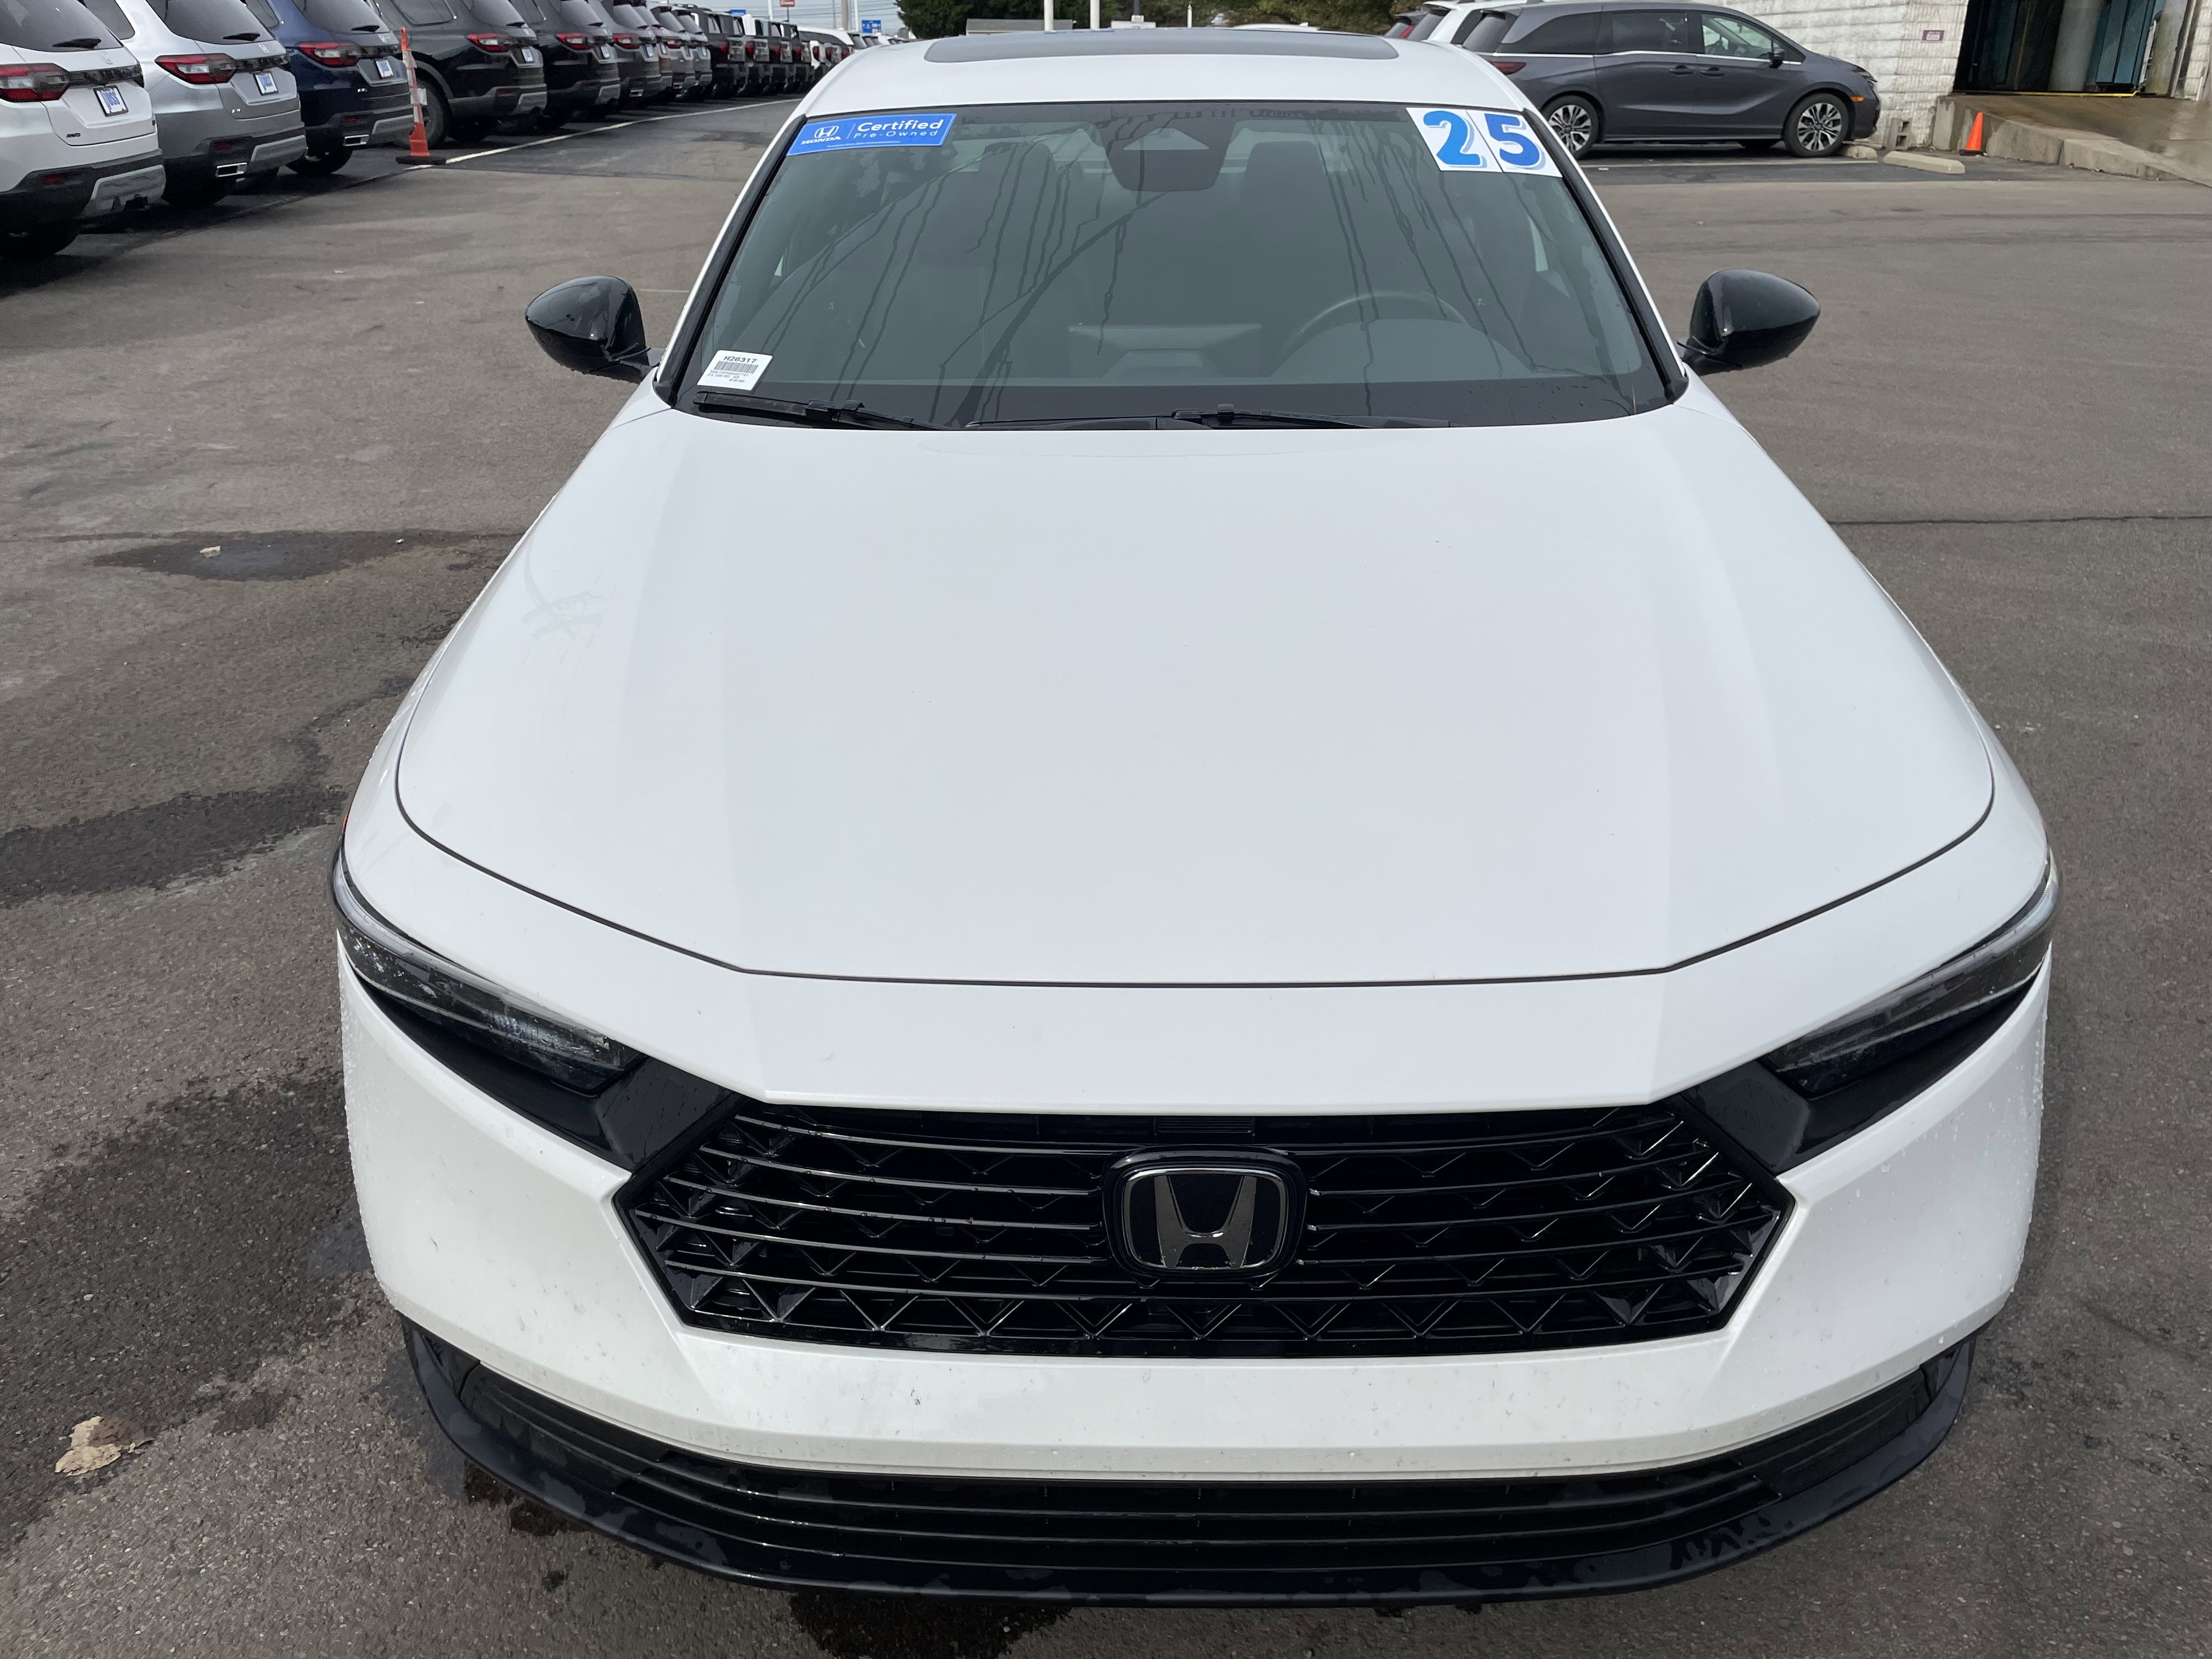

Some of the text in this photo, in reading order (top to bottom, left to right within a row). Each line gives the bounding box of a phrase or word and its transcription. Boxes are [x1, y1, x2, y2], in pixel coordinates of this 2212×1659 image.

[857, 119, 944, 132] Certified
[853, 130, 938, 139] Pre-Owned
[1423, 110, 1543, 167] 25
[801, 136, 842, 145] HONDA
